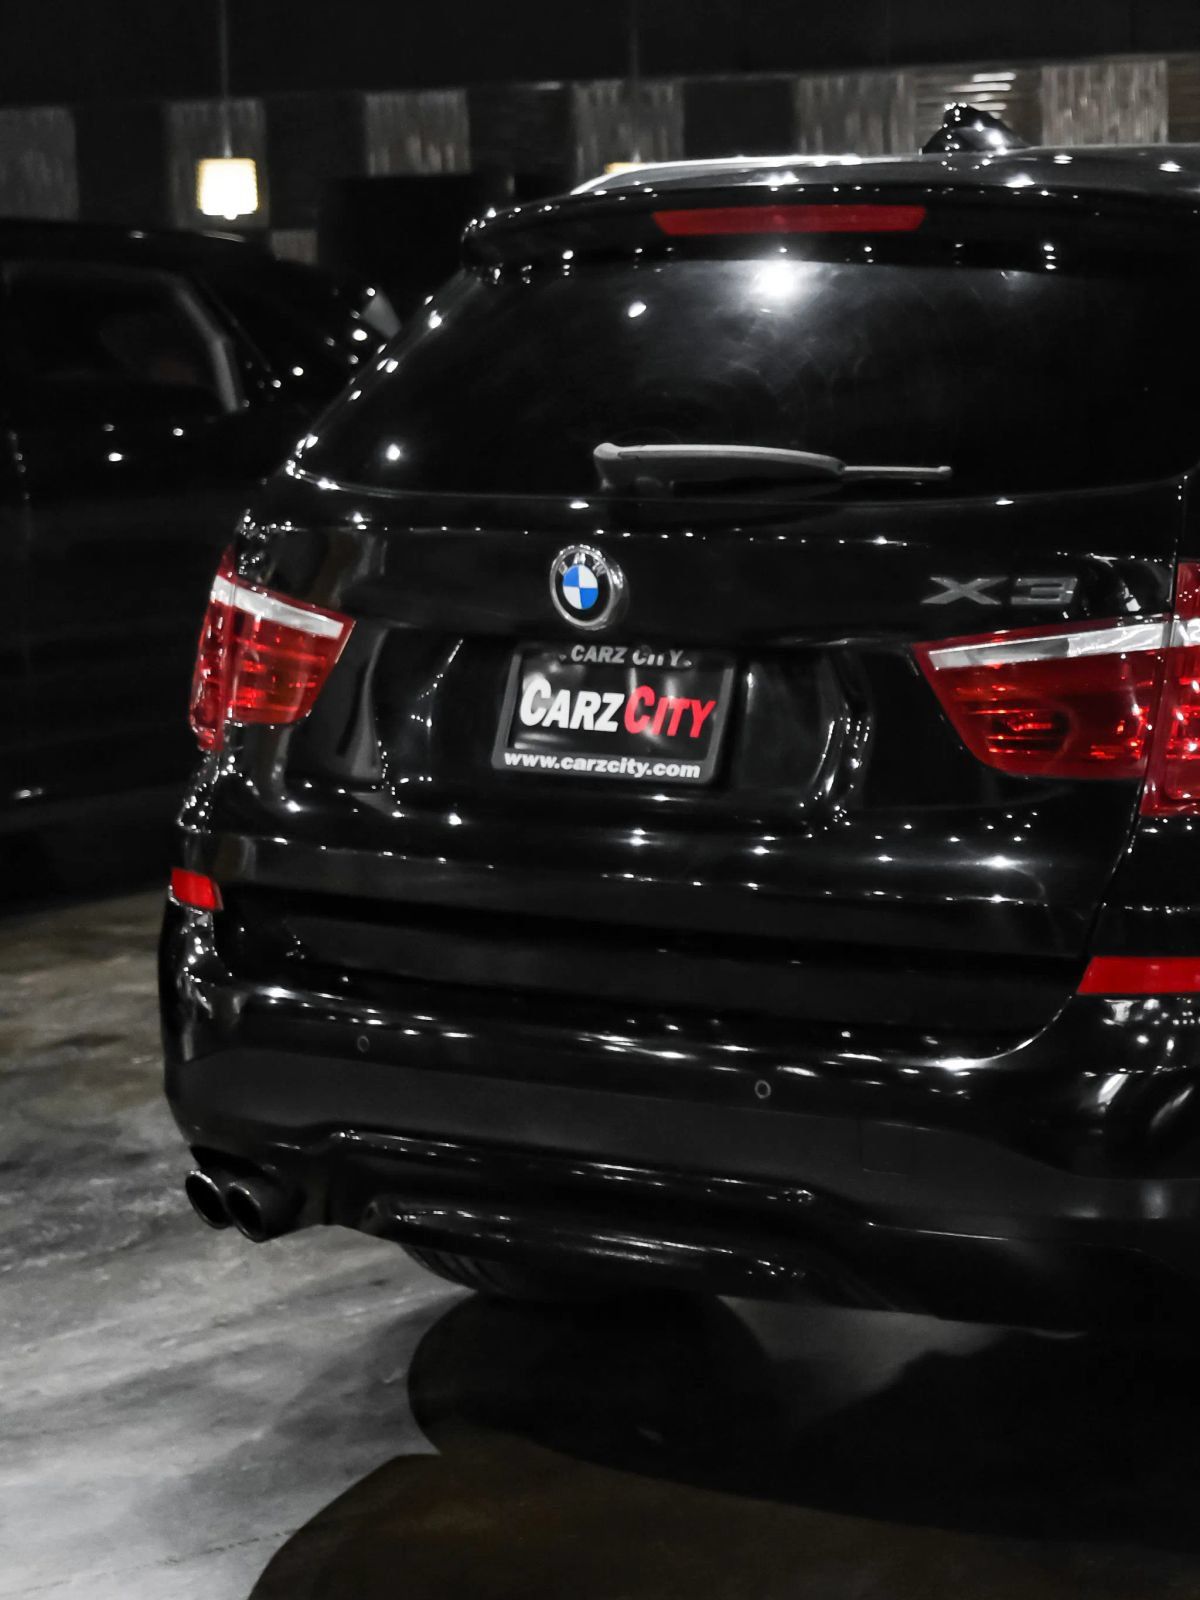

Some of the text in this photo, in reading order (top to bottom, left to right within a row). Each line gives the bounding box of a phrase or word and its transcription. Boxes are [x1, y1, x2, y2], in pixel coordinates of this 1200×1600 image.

[919, 576, 1079, 605] X3
[571, 644, 629, 664] CARZ
[504, 751, 700, 778] www.carzcity.com
